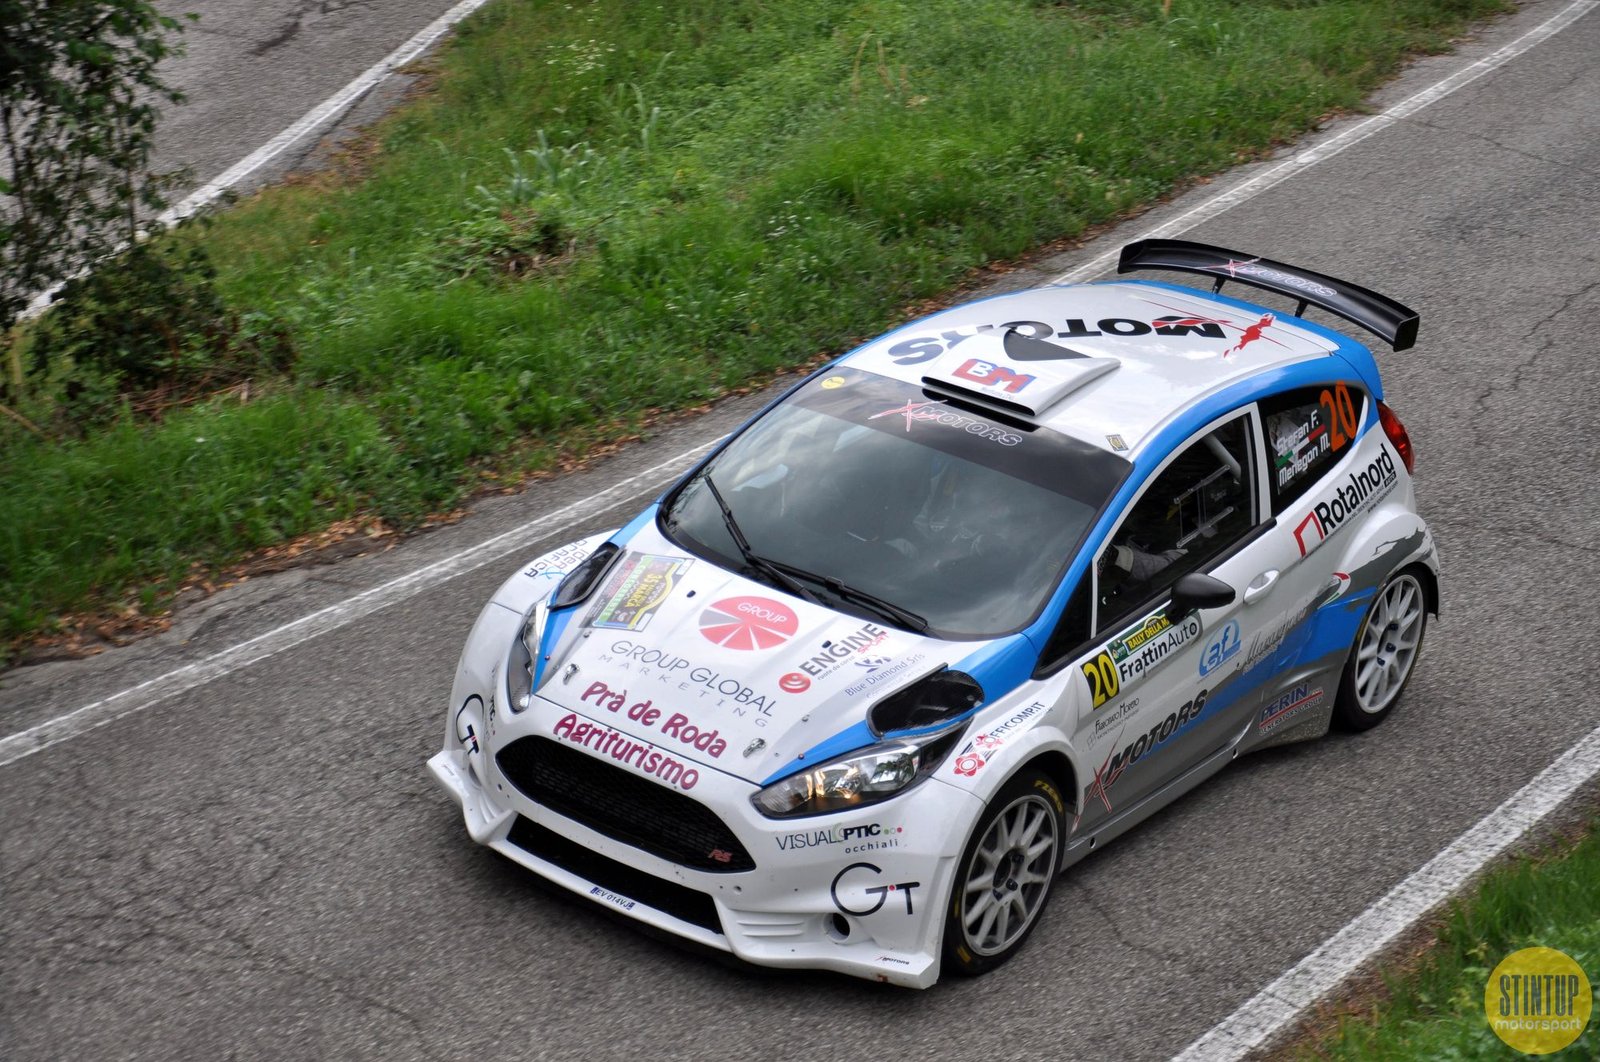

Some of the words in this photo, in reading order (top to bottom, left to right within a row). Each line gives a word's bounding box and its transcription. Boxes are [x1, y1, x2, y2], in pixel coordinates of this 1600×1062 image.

[951, 358, 1037, 394] BM
[1276, 420, 1309, 457] Stefan
[1319, 380, 1357, 452] 20
[1278, 447, 1319, 487] Menegon
[1314, 443, 1395, 536] Rotalnord
[737, 601, 788, 625] GROUP
[1127, 633, 1145, 651] RALLY
[1144, 622, 1161, 638] DELLA
[799, 623, 887, 676] ENGINE
[1119, 622, 1198, 682] FrattinAuto
[599, 653, 769, 729] MARKETING
[610, 640, 689, 672] GROUP
[690, 667, 777, 717] GLOBAL
[845, 684, 867, 697] Blue
[865, 660, 908, 686] Diamond
[1082, 653, 1119, 709] 20
[580, 681, 627, 712] Prà
[627, 700, 661, 726] de
[661, 712, 728, 759] Roda
[553, 713, 700, 790] Agriturismo
[845, 838, 899, 854] occhiali
